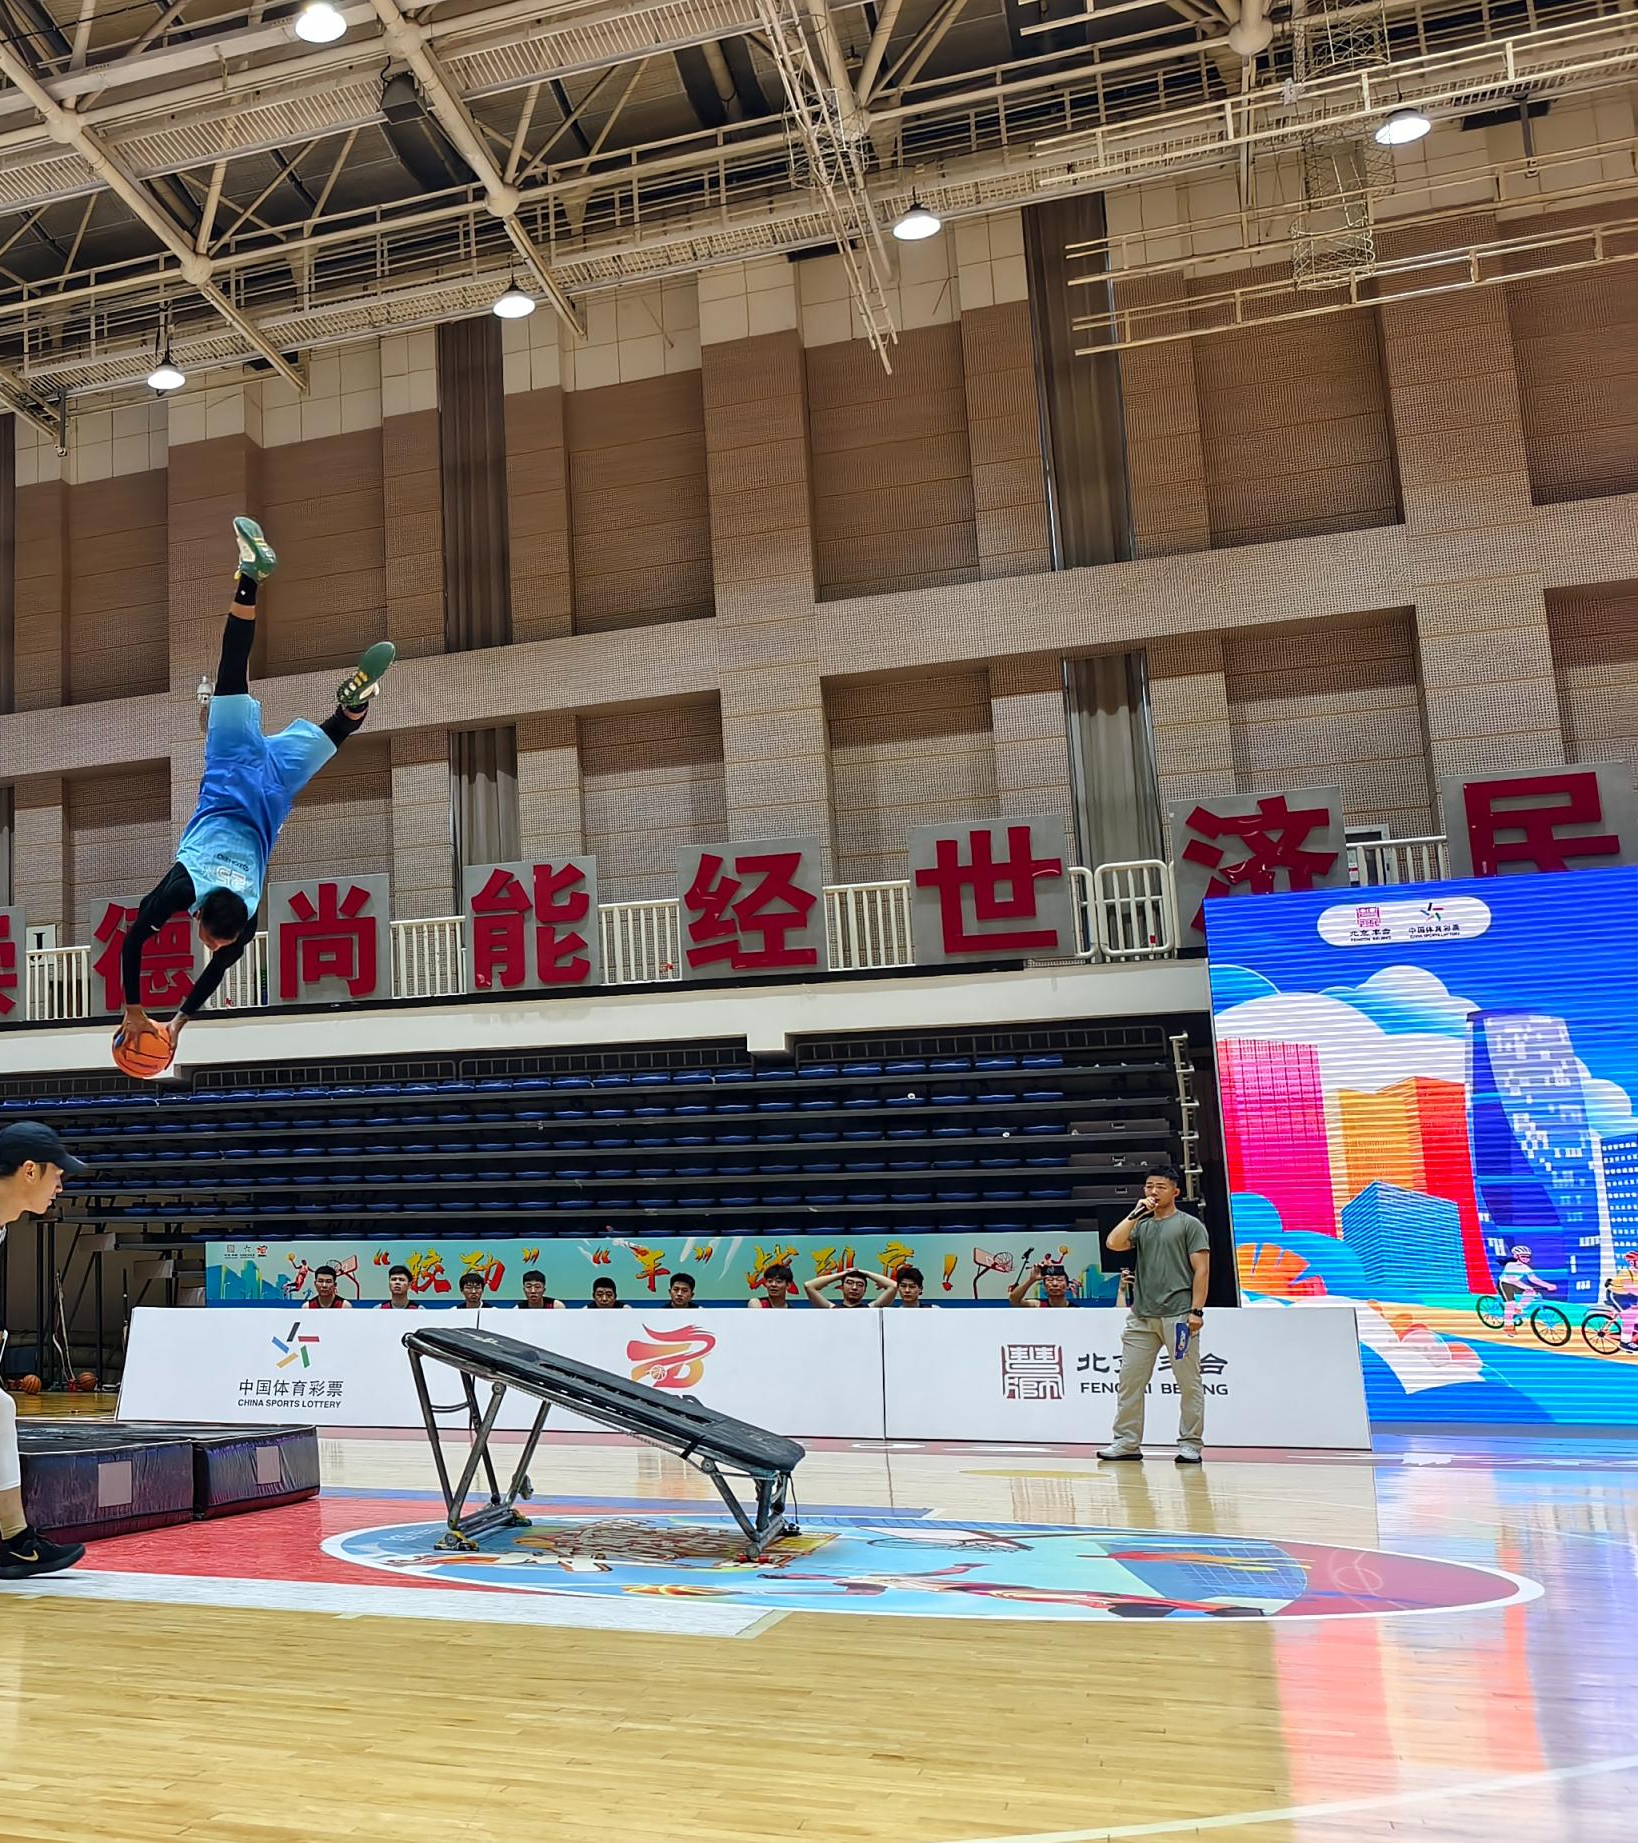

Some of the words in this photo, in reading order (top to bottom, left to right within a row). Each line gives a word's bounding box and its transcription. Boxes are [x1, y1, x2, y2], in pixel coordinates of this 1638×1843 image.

[239, 1378, 344, 1398] 中国体育彩票
[237, 1399, 264, 1407] CHINA
[265, 1399, 300, 1407] SPORTS
[301, 1400, 342, 1408] LOTTERY
